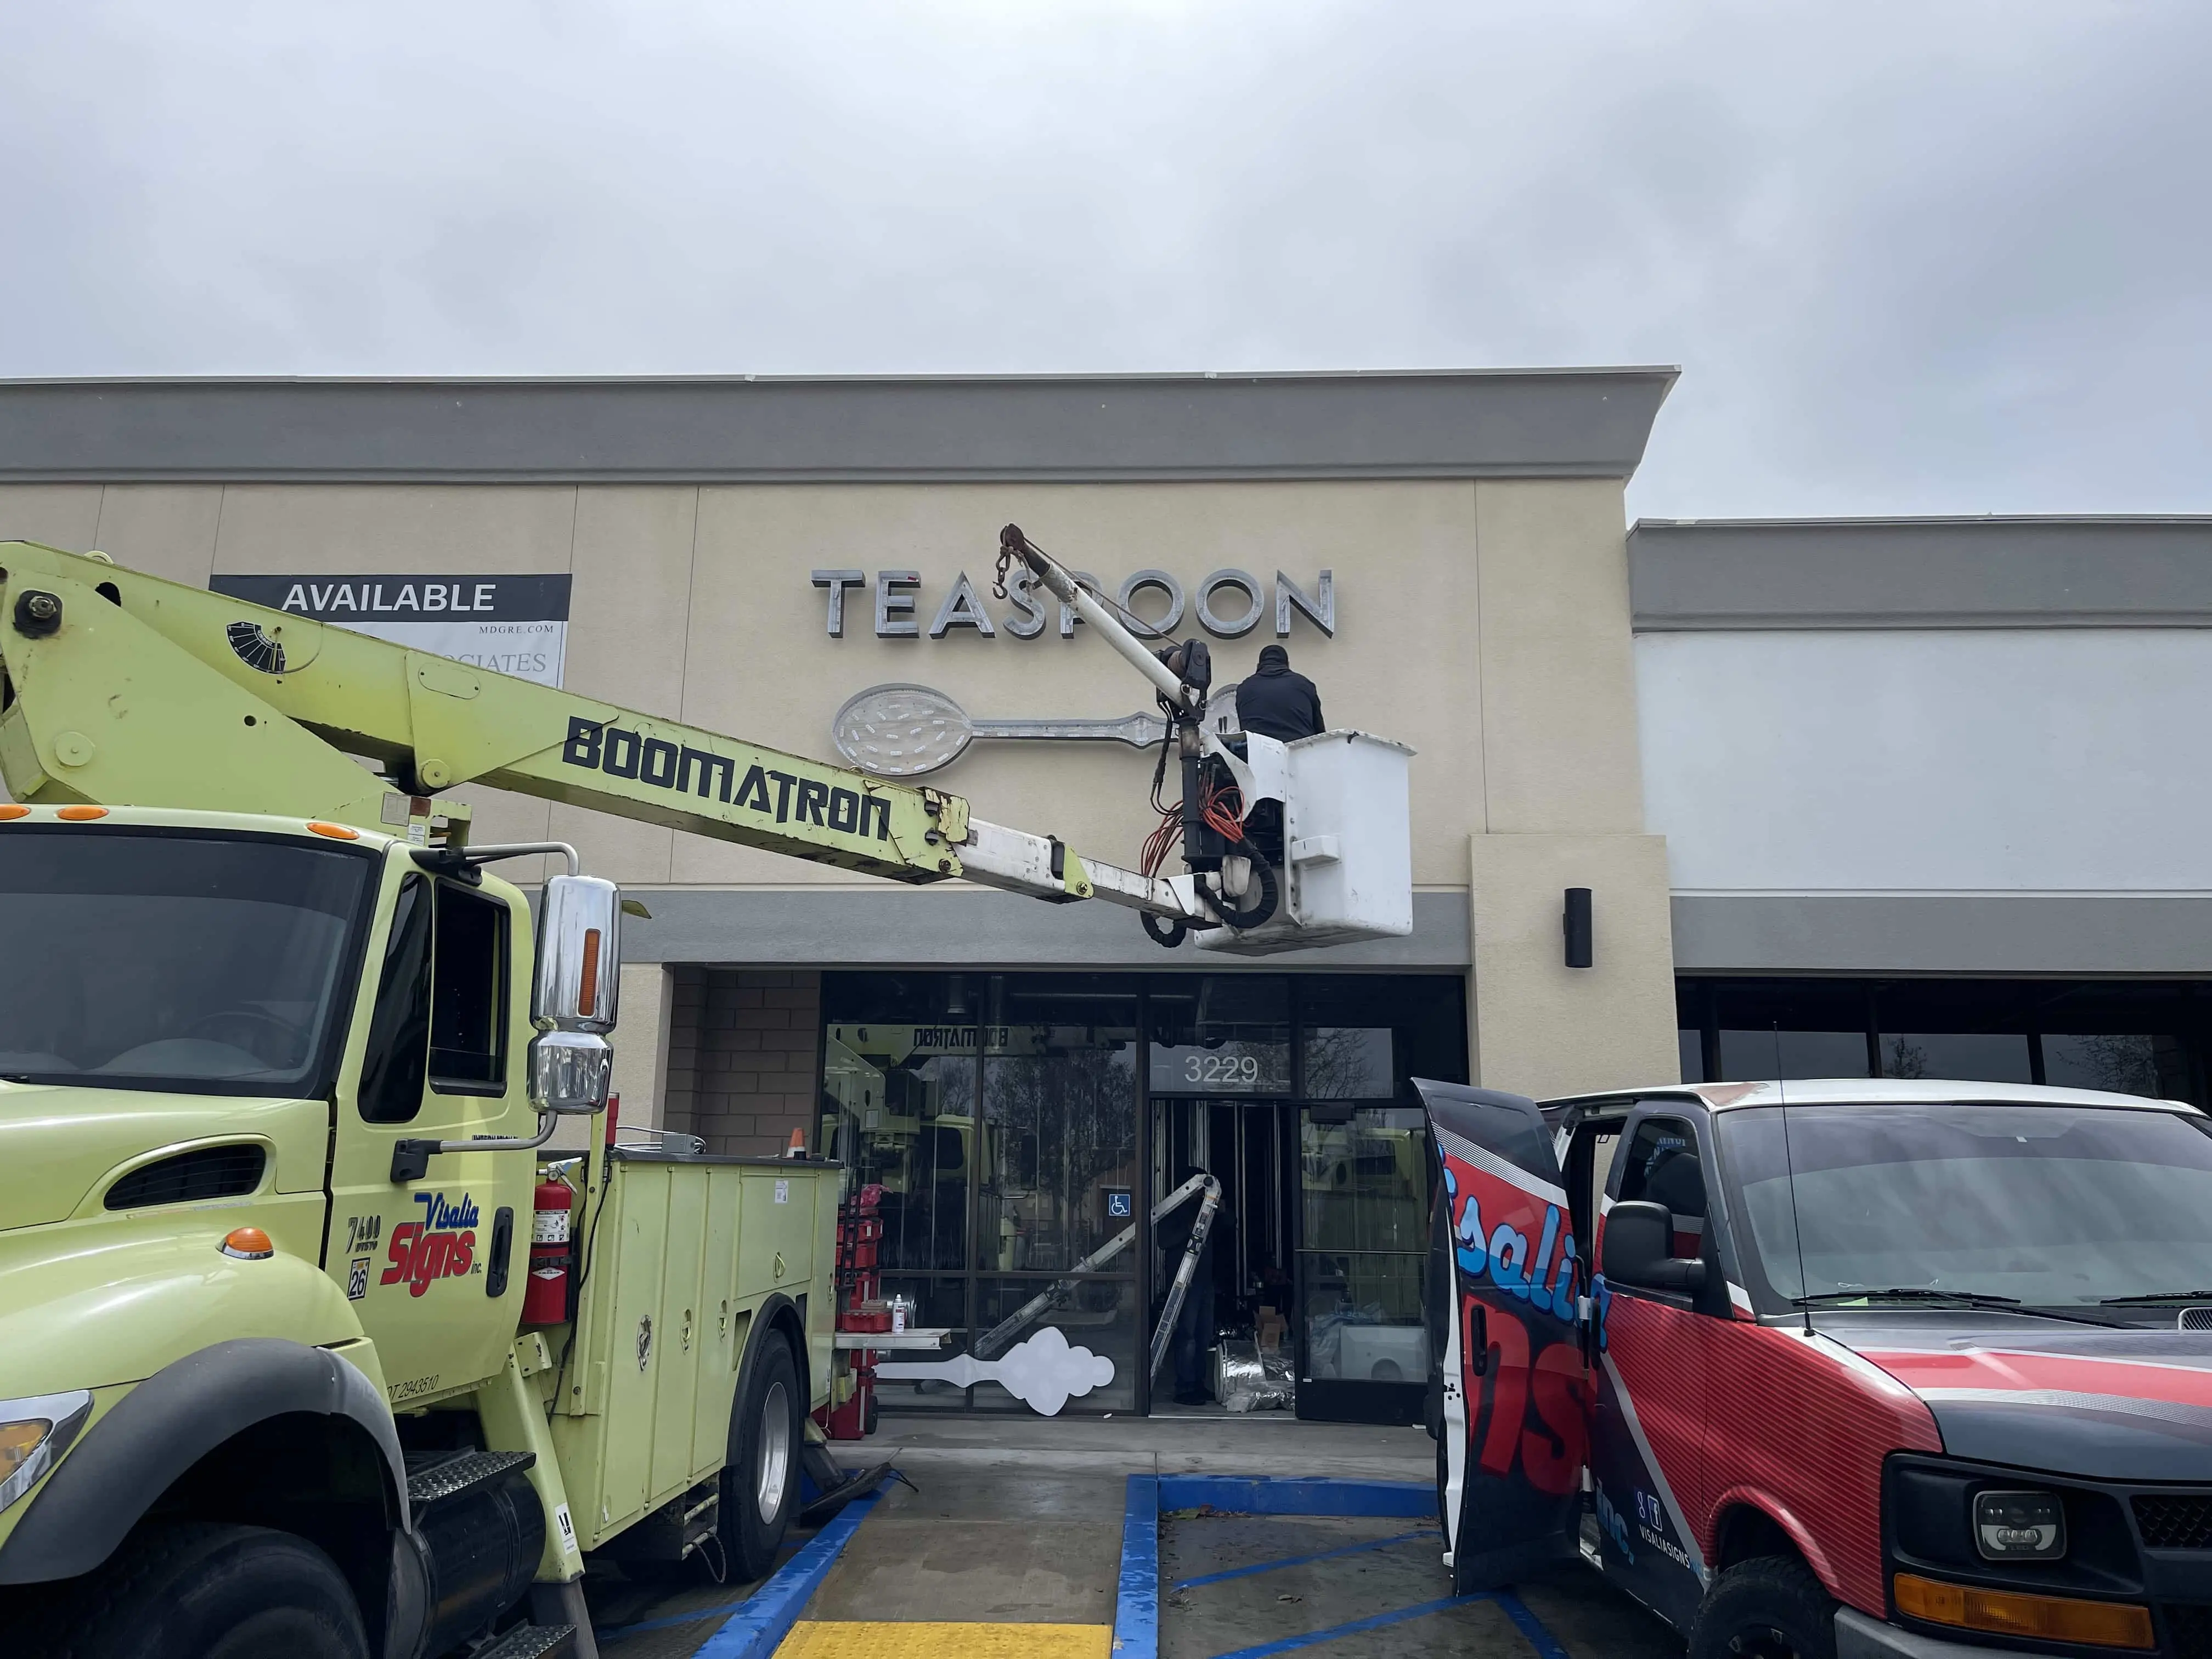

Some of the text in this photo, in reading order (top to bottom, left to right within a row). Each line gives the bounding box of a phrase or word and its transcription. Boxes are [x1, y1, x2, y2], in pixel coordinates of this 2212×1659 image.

[281, 583, 496, 612] AVAILABLE
[811, 569, 1335, 641] TEASPOON
[479, 624, 554, 634] MDGRE.COM
[562, 715, 891, 842] BOOMATRON
[1184, 1055, 1259, 1084] 3229
[414, 1192, 479, 1231] Visalia
[346, 1215, 381, 1254] 7400
[380, 1221, 476, 1298] Signs
[470, 1260, 482, 1274] inc.
[348, 1269, 366, 1297] 26
[398, 1374, 439, 1398] 2943510
